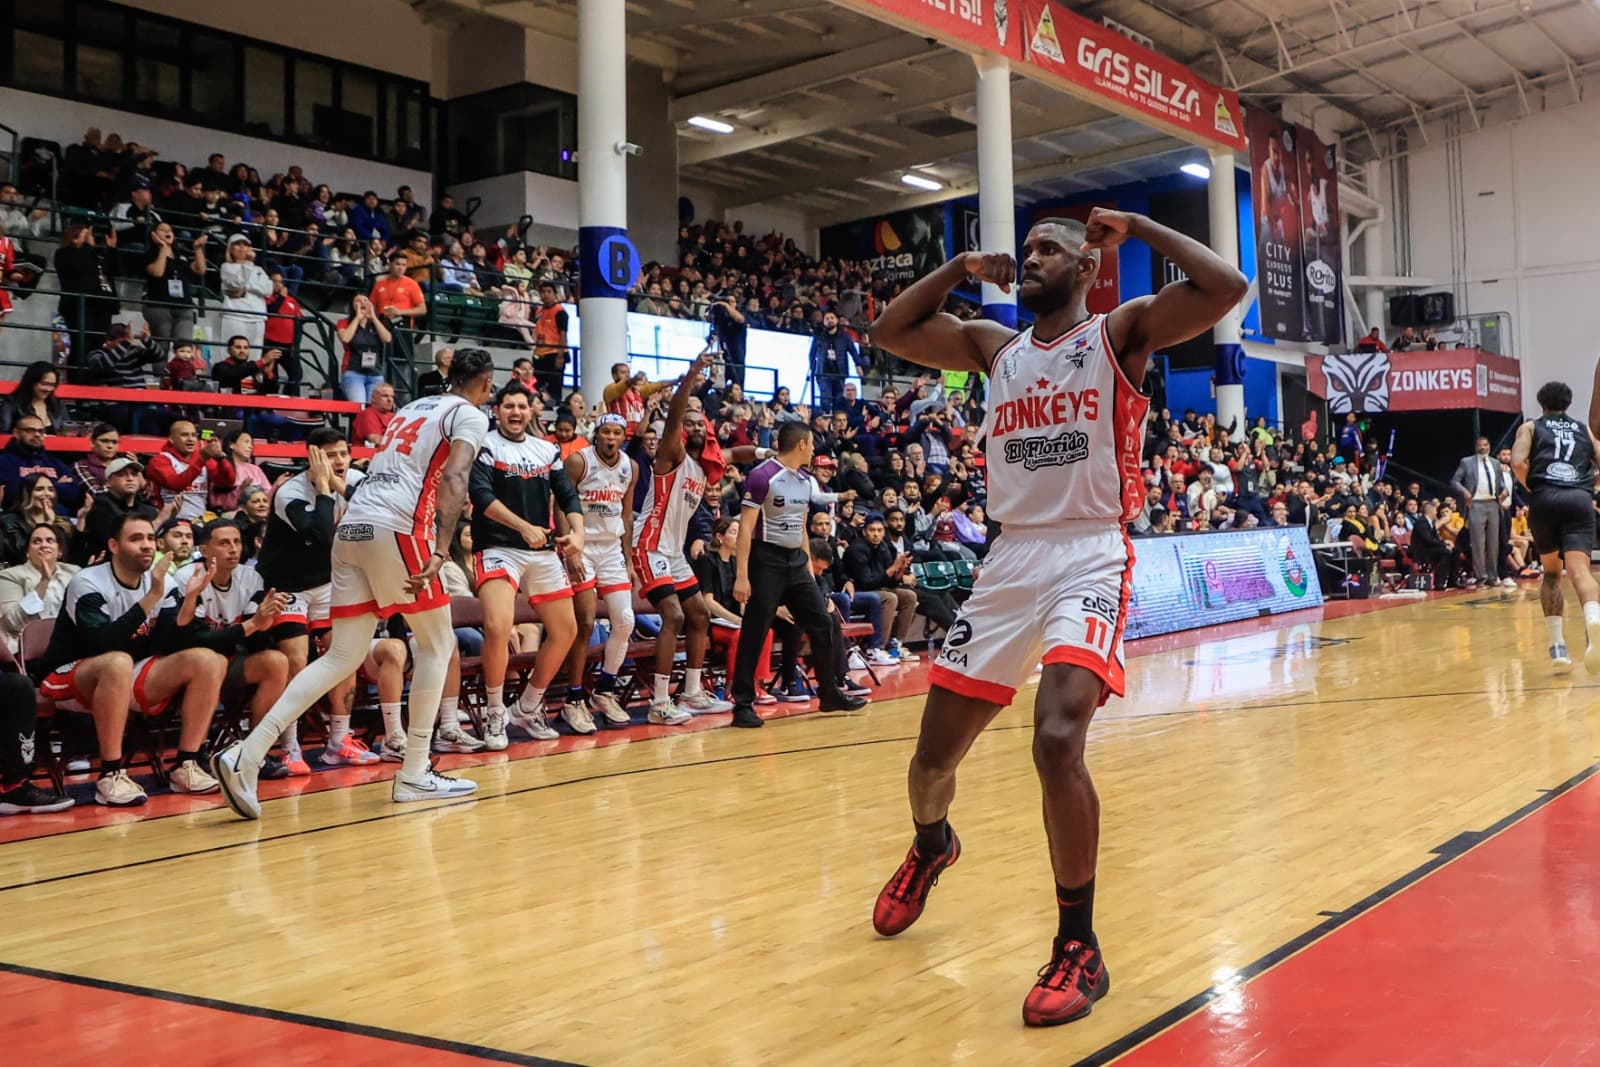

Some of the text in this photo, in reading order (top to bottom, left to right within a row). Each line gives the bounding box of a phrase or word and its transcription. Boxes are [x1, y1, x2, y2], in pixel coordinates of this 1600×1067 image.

[1077, 37, 1201, 117] GAS SILZA
[609, 241, 631, 286] B
[1265, 241, 1291, 261] CITY
[1267, 271, 1293, 290] PLUS
[1391, 368, 1473, 392] ZONKEYS
[992, 388, 1100, 438] ZONKEYS
[1006, 441, 1023, 461] El
[1026, 431, 1086, 459] Florido
[1554, 436, 1576, 461] 17
[1085, 616, 1108, 651] 11
[939, 646, 968, 668] EGA
